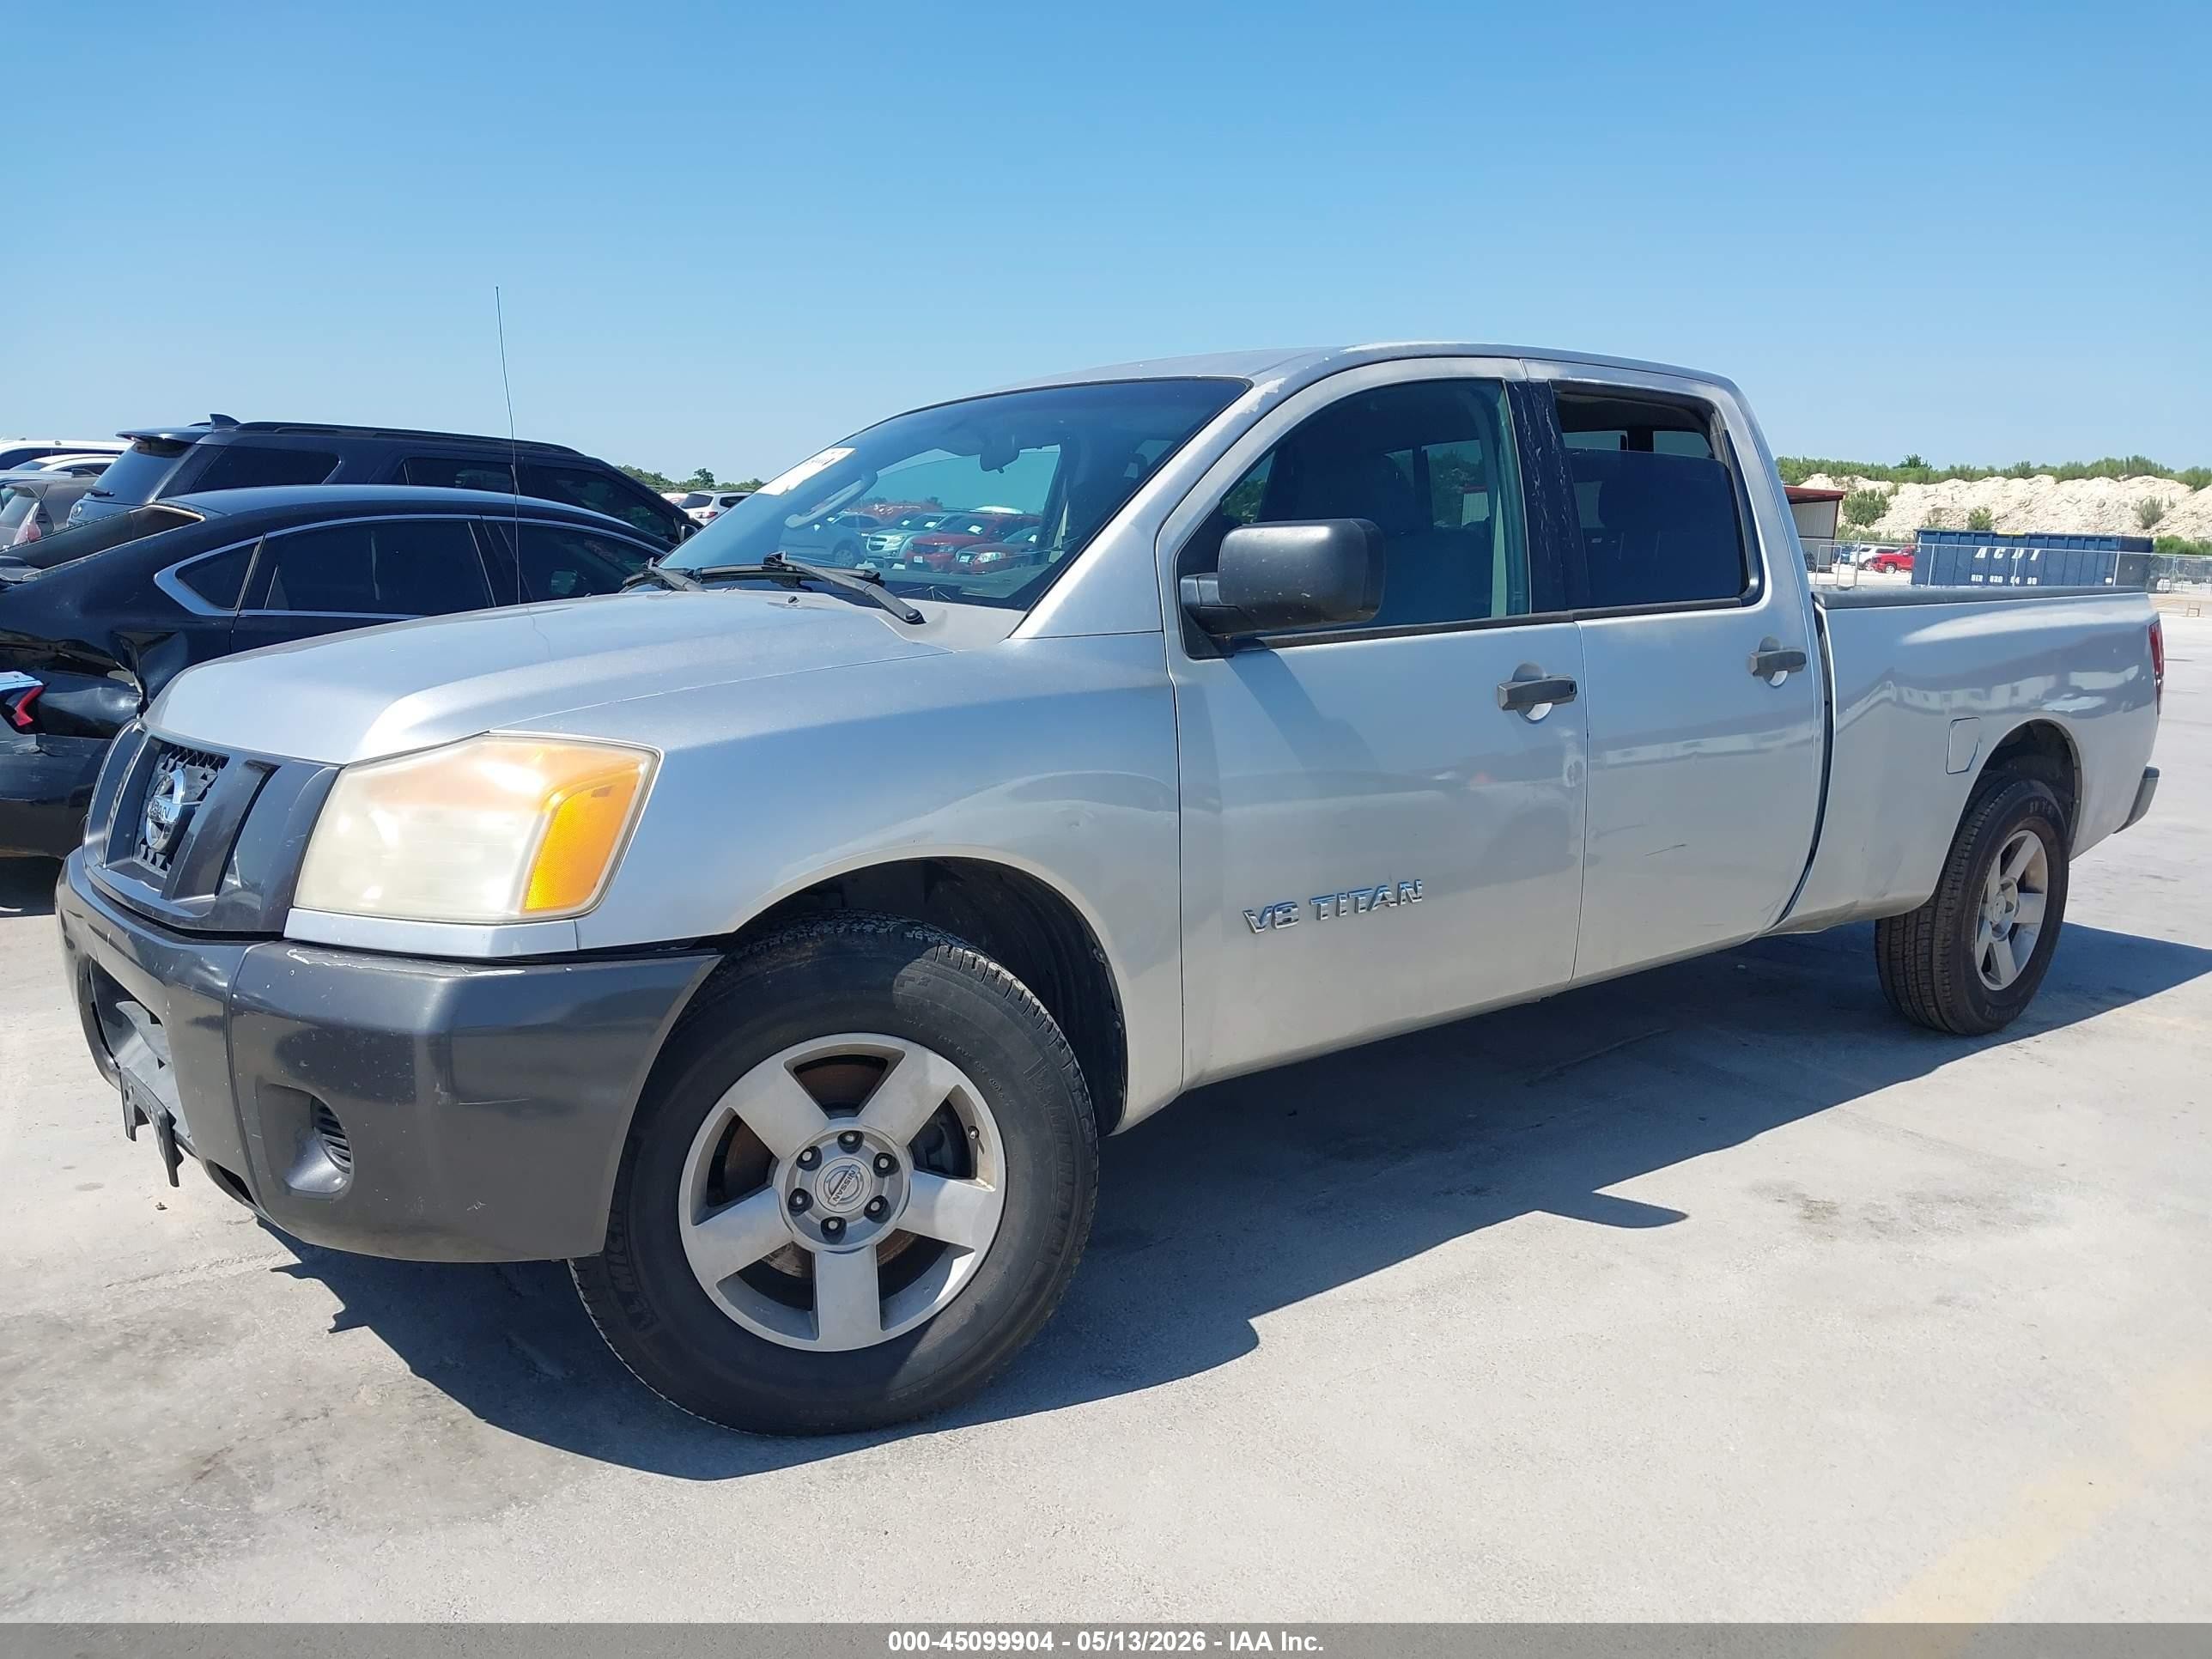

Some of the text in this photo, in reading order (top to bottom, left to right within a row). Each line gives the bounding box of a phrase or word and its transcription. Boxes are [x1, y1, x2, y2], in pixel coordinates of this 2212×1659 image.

[1243, 879, 1423, 934] V8 TITAN
[832, 1170, 857, 1202] NISSAN
